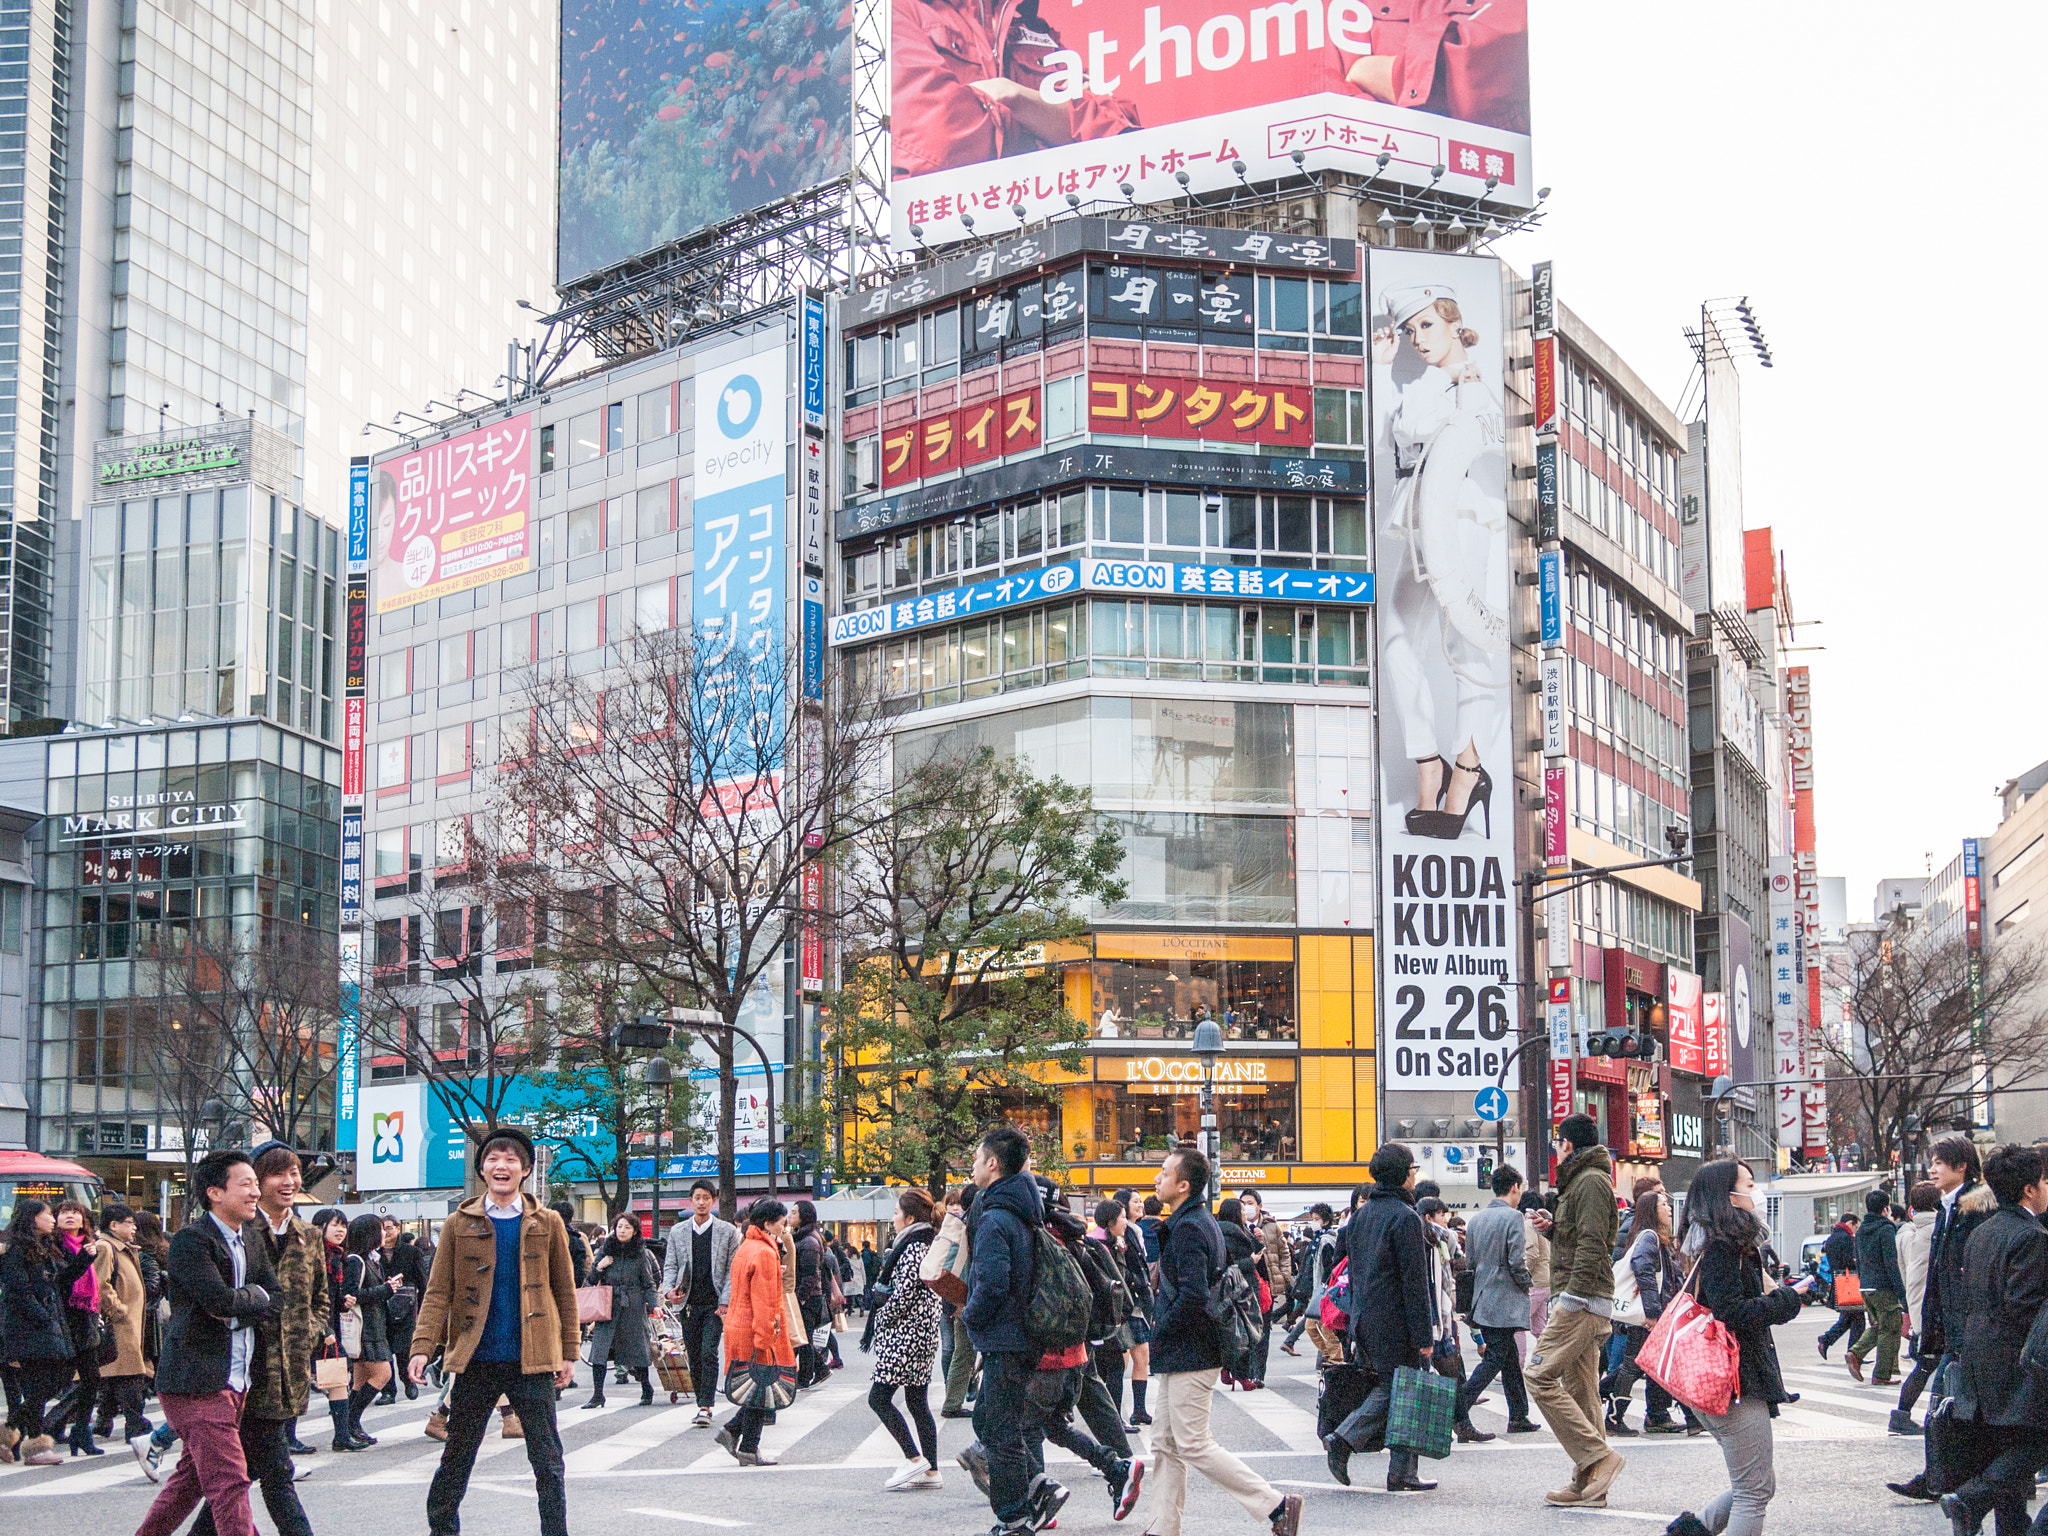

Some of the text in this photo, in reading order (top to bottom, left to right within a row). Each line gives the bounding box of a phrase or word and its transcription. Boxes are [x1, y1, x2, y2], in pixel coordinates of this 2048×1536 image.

[1039, 0, 1372, 105] at home
[1277, 124, 1399, 154] アットホーム
[1459, 148, 1504, 178] 検索
[907, 139, 1240, 225] 住まいさがしはアットホーム
[1110, 266, 1129, 278] 9F
[977, 296, 992, 312] 9F
[808, 316, 820, 406] 東急リバブル
[808, 413, 820, 424] 9F
[1092, 381, 1304, 430] コンタクト
[885, 396, 1037, 474] プライス
[1544, 424, 1555, 432] 8F
[102, 445, 236, 478] MARK CITY
[135, 439, 200, 456] SHIBUYA
[705, 439, 774, 479] eyecity
[1095, 454, 1113, 470] 7F
[400, 428, 527, 502] 品川スキン
[1058, 457, 1073, 474] 7F
[1171, 463, 1278, 476] MODERN JAPANESE DINING
[352, 481, 366, 557] 東急リバブル
[400, 469, 526, 542] クリニック
[808, 469, 820, 549] 献血ルーム
[459, 520, 503, 544] 美容皮フ科
[1544, 527, 1555, 537] 7F
[352, 562, 364, 570] 9F
[406, 544, 433, 565] 当ビル
[808, 553, 819, 562] 6F
[411, 565, 427, 582] 4F
[1047, 570, 1067, 589] 6F
[1092, 562, 1166, 589] AEON
[1181, 566, 1367, 598] 英会話イーオン
[896, 577, 1034, 629] 英会話イーオン
[1545, 561, 1557, 639] 英会話イーオン
[349, 604, 364, 671] アメリカン
[704, 514, 740, 754] アイシティ
[750, 503, 772, 747] コンタクトの
[835, 609, 885, 641] AEON
[1546, 640, 1557, 648] 6F
[348, 677, 363, 687] 8F
[1547, 668, 1559, 749] 渋谷駅前ビル
[348, 700, 361, 751] 外貨両替
[1547, 770, 1564, 781] 5F
[109, 790, 195, 808] SHIBUYA
[347, 795, 359, 803] 7F
[63, 804, 247, 834] MARK CITY
[111, 844, 189, 860] 渋谷 マークシティ
[808, 834, 820, 844] 4F
[344, 819, 360, 904] 加藤眼科
[1393, 854, 1506, 899] KODA
[343, 909, 359, 921] 5F
[1394, 902, 1506, 947] KUMI
[1394, 954, 1507, 976] New Album
[1775, 917, 1791, 1005] 洋装生地
[806, 979, 818, 989] 7F
[1396, 985, 1507, 1041] 2.26
[1670, 1009, 1696, 1040] アコム
[1558, 1008, 1569, 1055] 渋谷駅前
[1706, 1027, 1719, 1061] アコム
[1396, 1046, 1430, 1077] On
[1680, 1048, 1688, 1065] 3F
[1153, 1085, 1243, 1093] EN PROENCE
[1777, 1030, 1796, 1128] マルナン
[1672, 1113, 1702, 1147] USH
